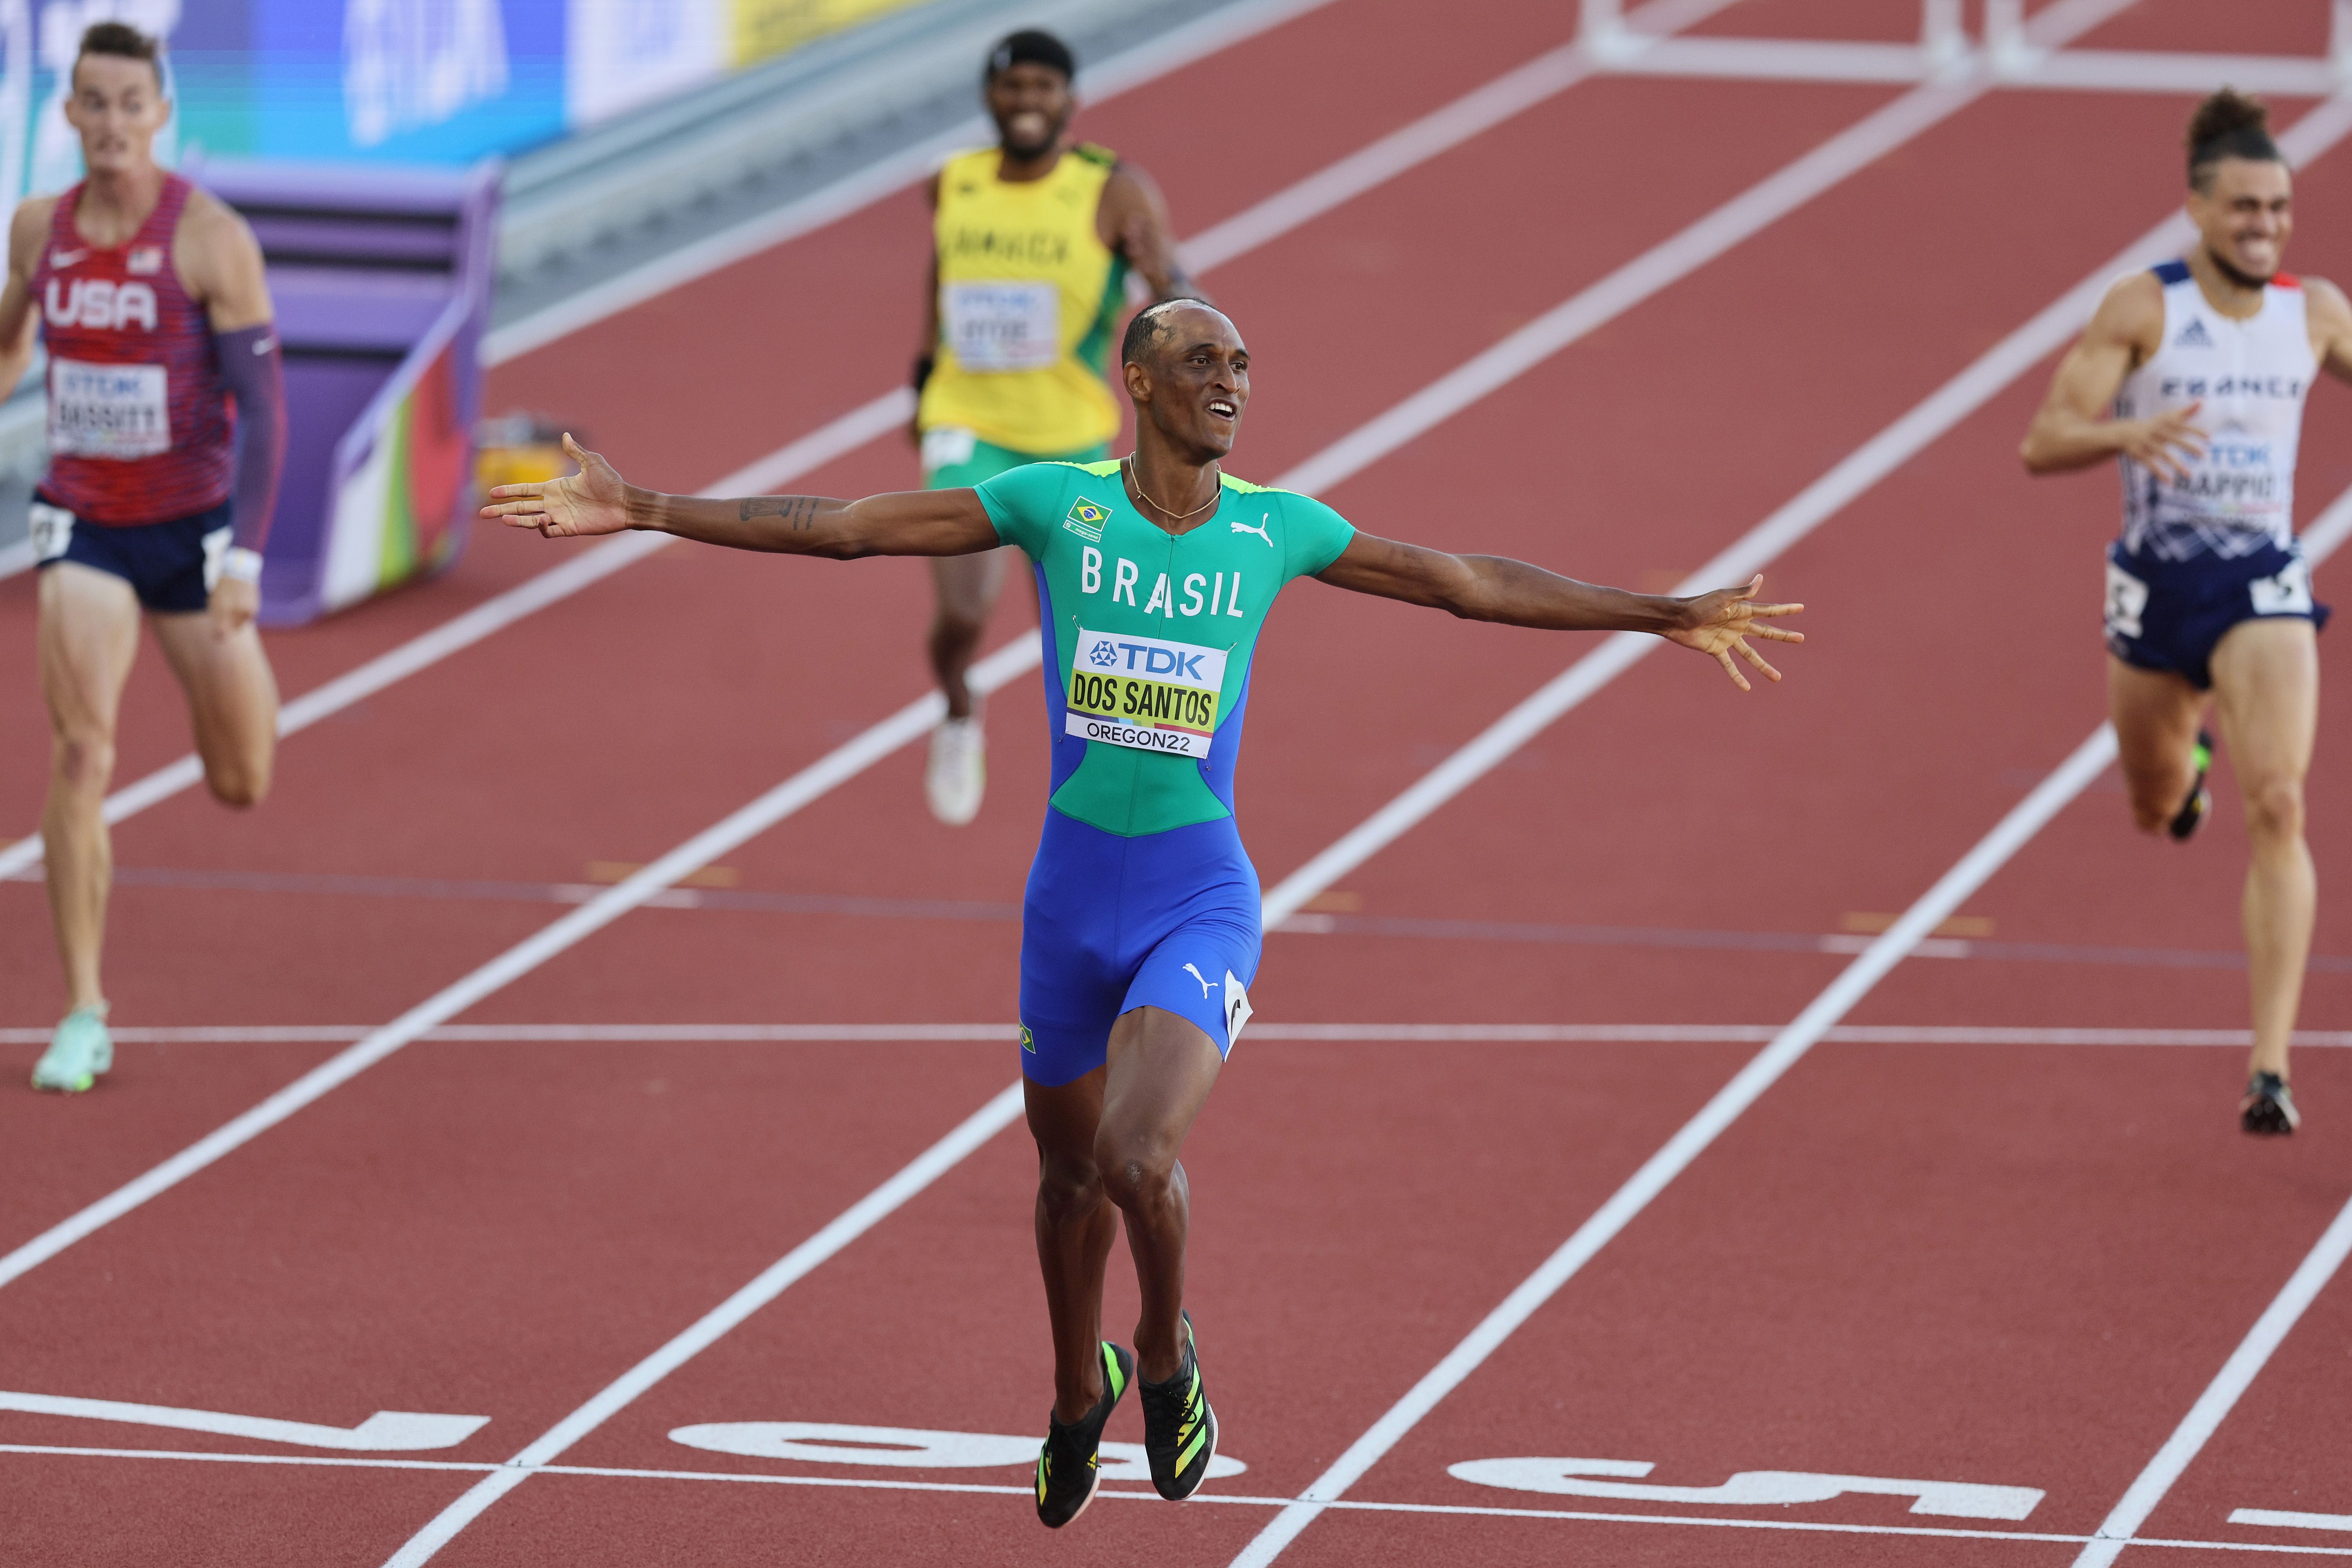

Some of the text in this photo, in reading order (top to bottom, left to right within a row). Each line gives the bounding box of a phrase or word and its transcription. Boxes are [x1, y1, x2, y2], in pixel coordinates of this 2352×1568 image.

[45, 278, 157, 332] USA
[1082, 545, 1244, 618] BRASIL
[1118, 642, 1206, 681] TDK
[1074, 673, 1212, 726] DOS SANTOS
[1087, 722, 1191, 752] OREGON22
